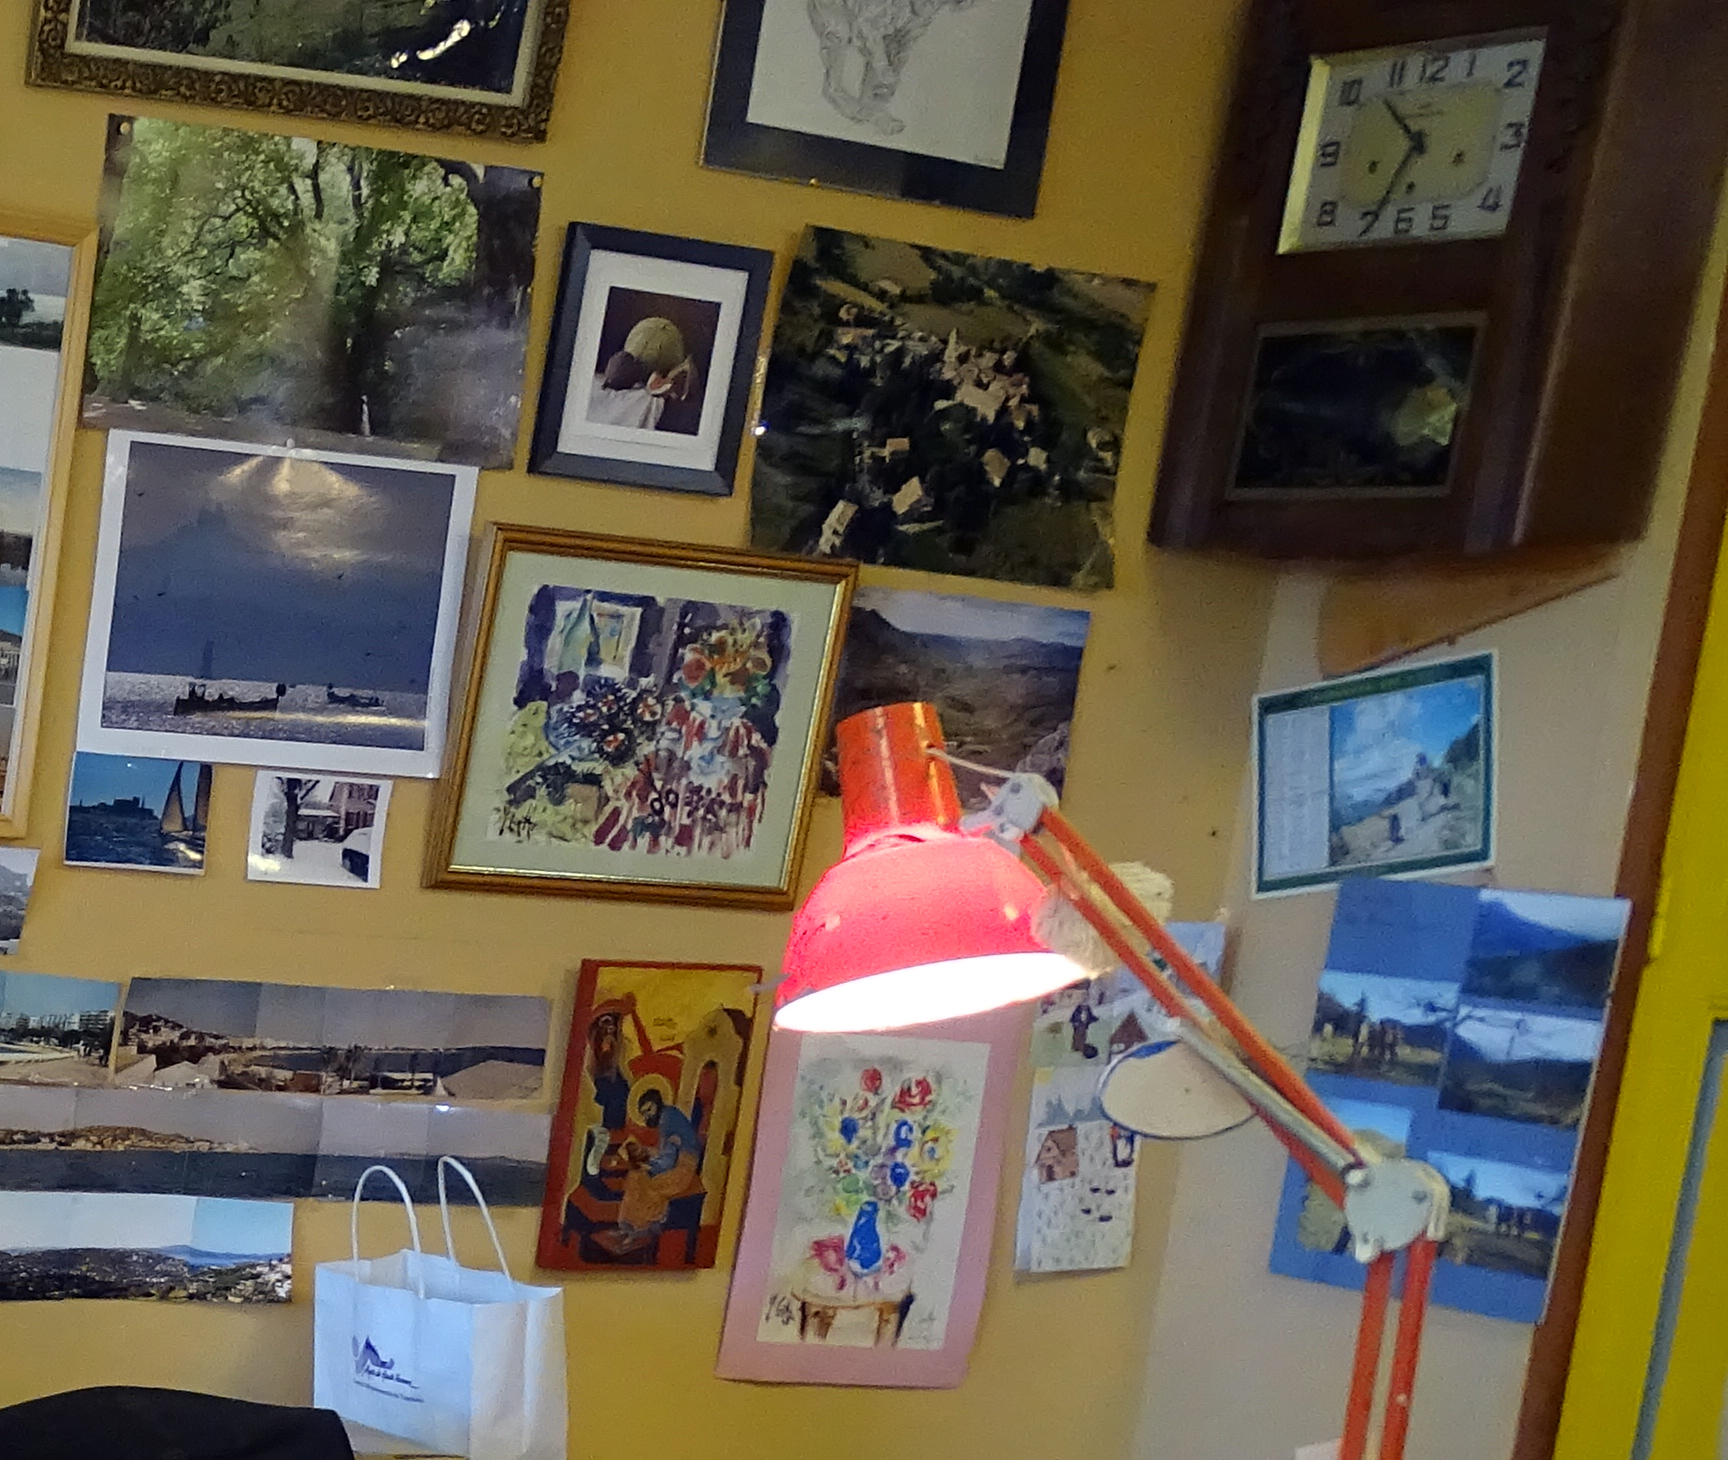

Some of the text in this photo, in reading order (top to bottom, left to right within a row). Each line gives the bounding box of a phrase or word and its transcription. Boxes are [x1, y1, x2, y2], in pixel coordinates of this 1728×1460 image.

[1420, 55, 1450, 83] 12
[1503, 59, 1530, 88] 2
[1500, 121, 1525, 151] 3
[1319, 141, 1341, 167] 9
[1477, 185, 1503, 213] 4
[1316, 201, 1338, 228] 8
[1358, 204, 1452, 237] 7 6 5
